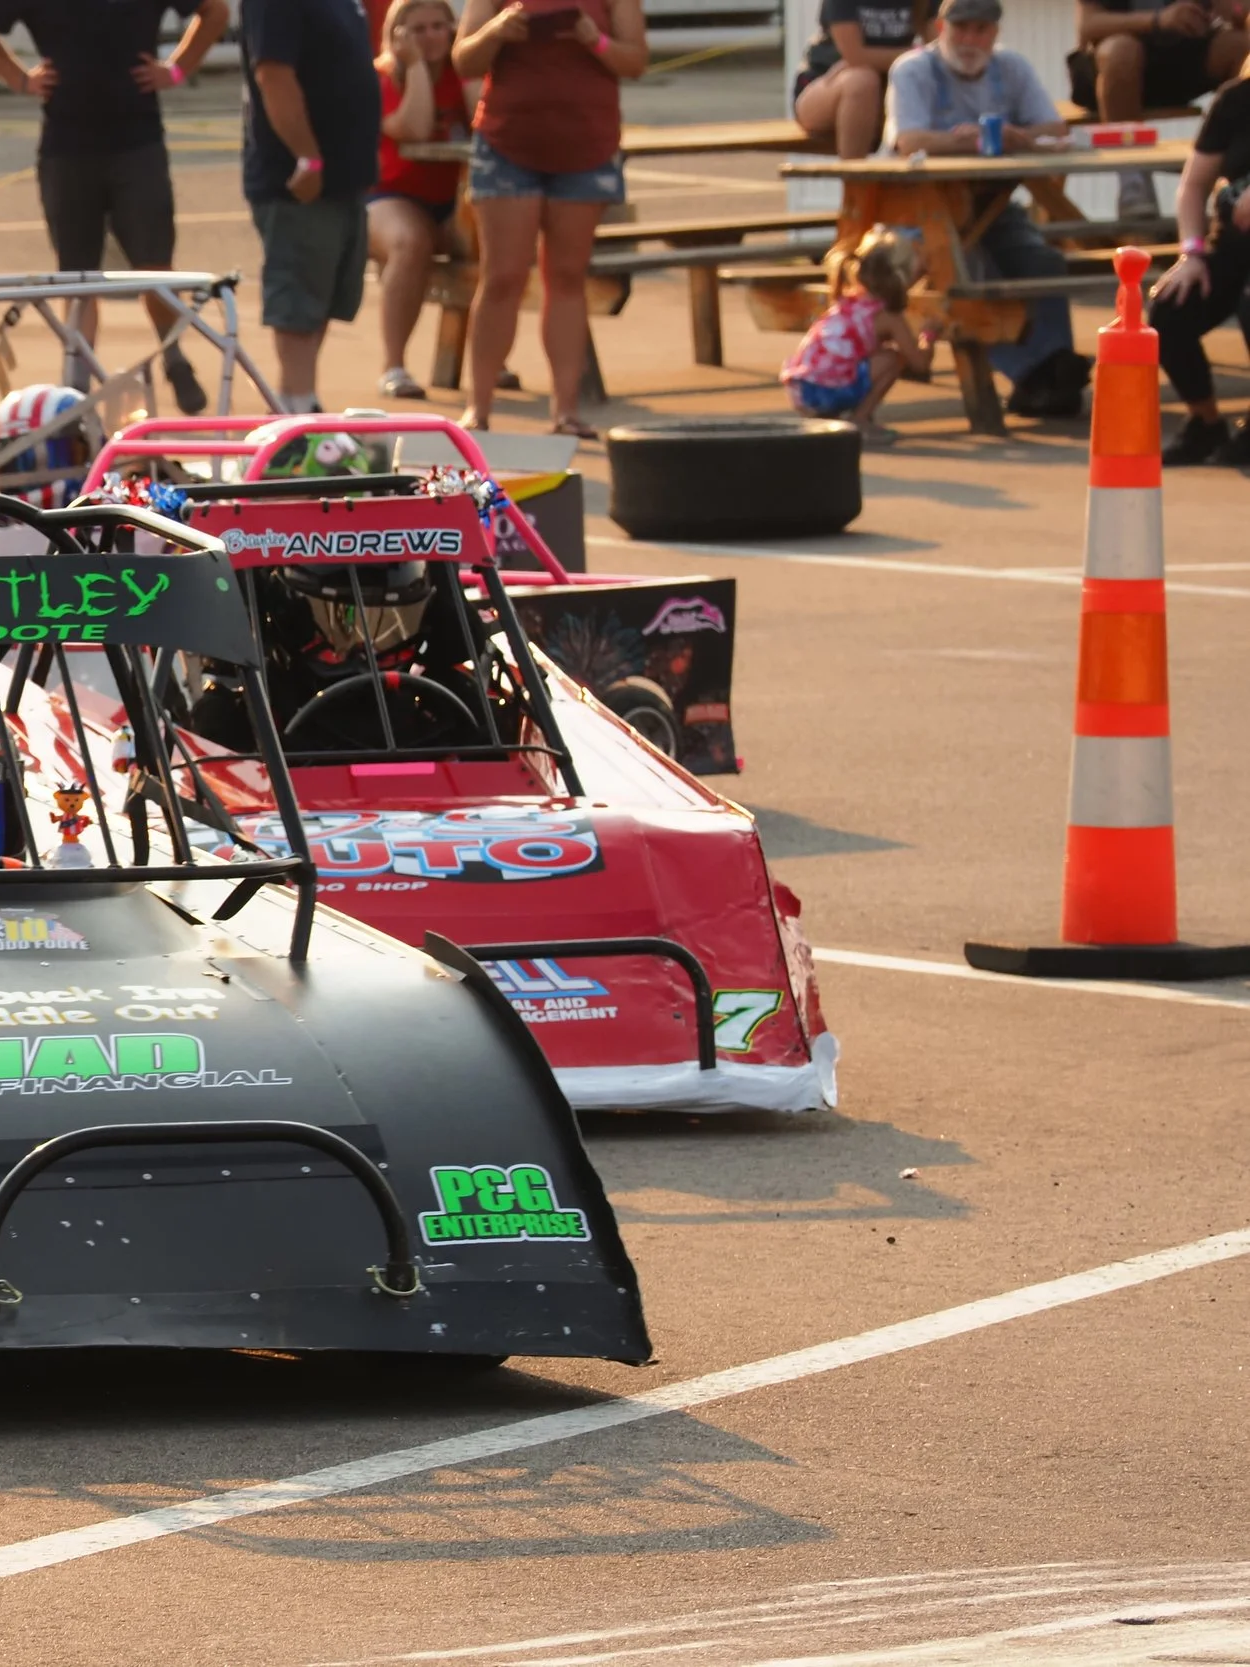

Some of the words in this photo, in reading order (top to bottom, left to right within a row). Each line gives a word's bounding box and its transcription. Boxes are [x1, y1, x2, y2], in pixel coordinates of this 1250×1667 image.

[283, 528, 462, 557] ANDREWS
[355, 881, 429, 892] SHOP
[118, 984, 227, 1001] Inn
[115, 1003, 220, 1022] Out
[544, 997, 588, 1010] AND
[519, 1006, 618, 1023] AGEMENT
[712, 988, 784, 1053] 7
[420, 1212, 589, 1243] ENTERPRISE
